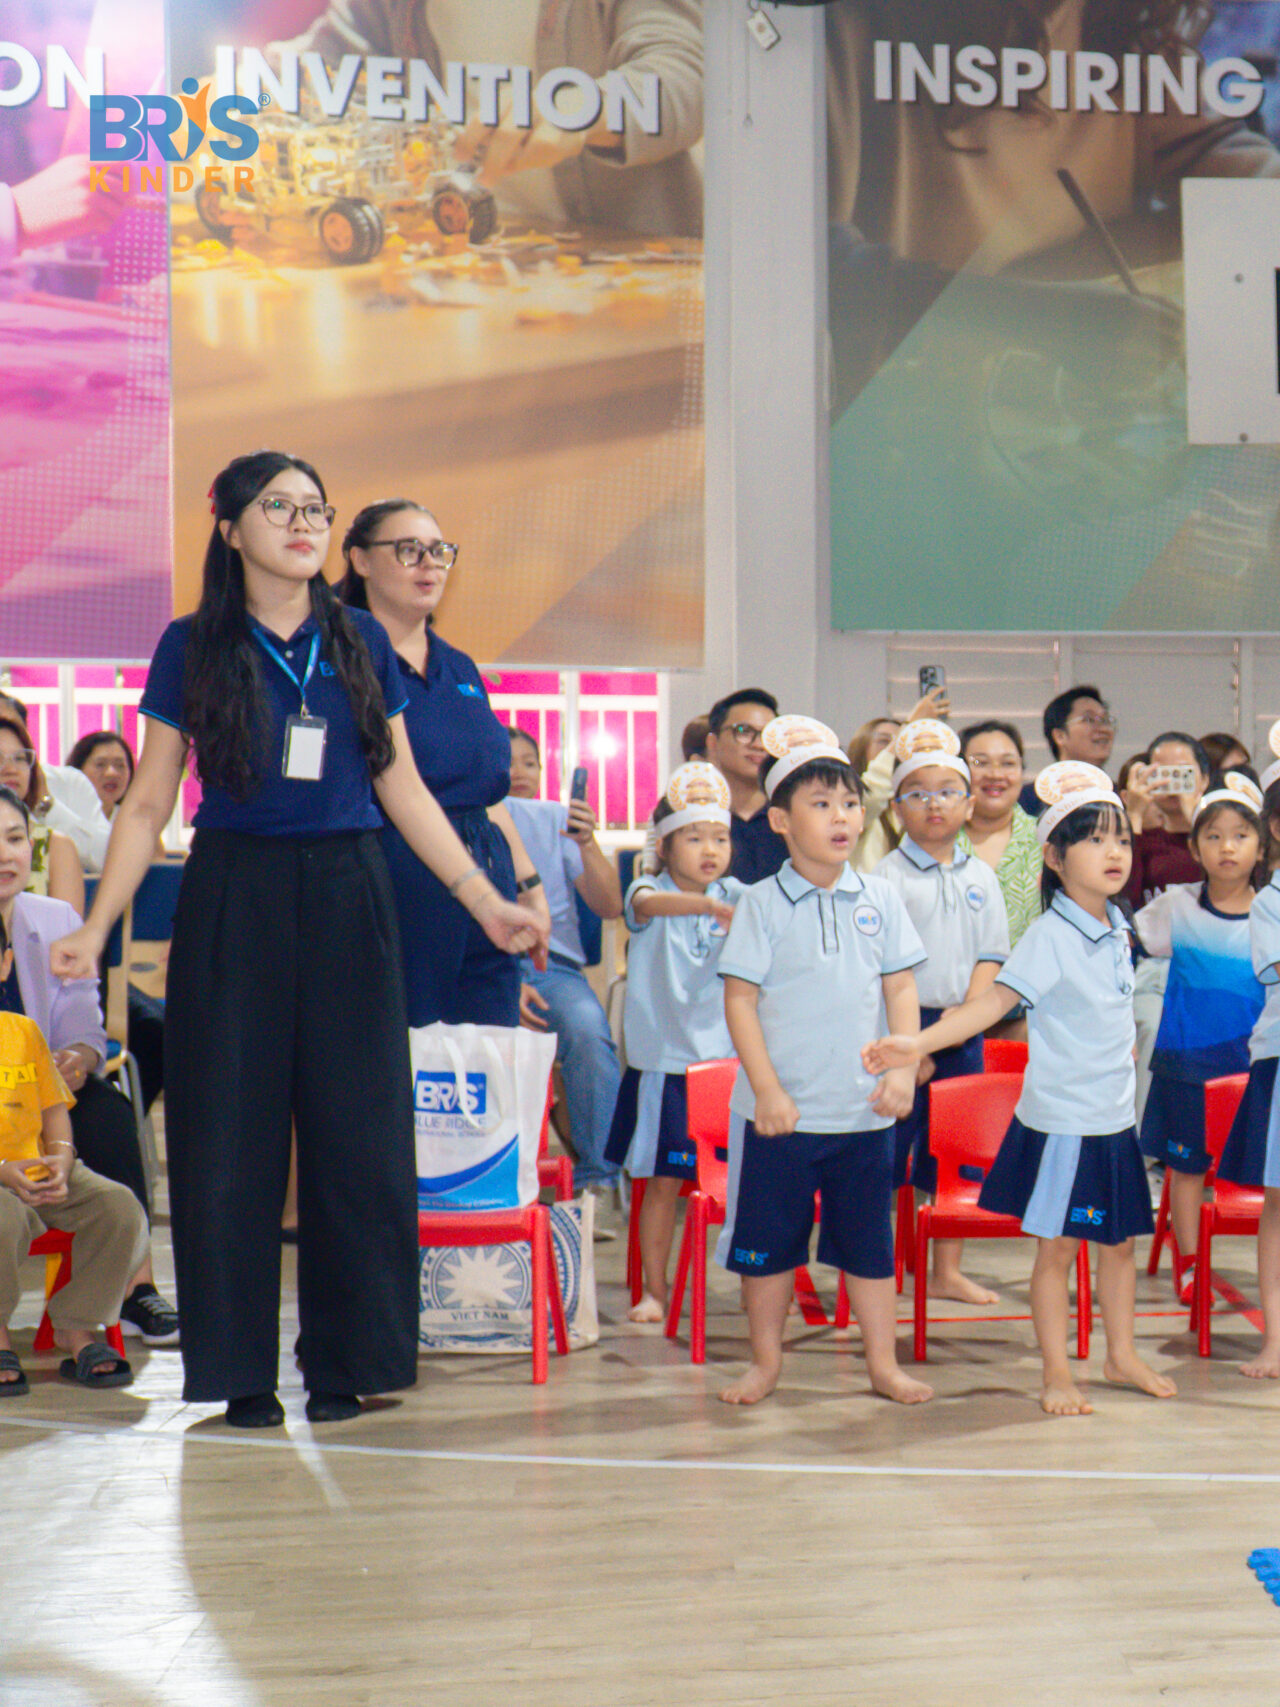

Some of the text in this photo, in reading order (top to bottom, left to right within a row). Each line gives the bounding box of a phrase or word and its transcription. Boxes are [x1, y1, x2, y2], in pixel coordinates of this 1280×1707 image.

[0, 41, 104, 109] ON
[215, 45, 660, 134] INVENTION
[873, 40, 1265, 118] INSPIRING
